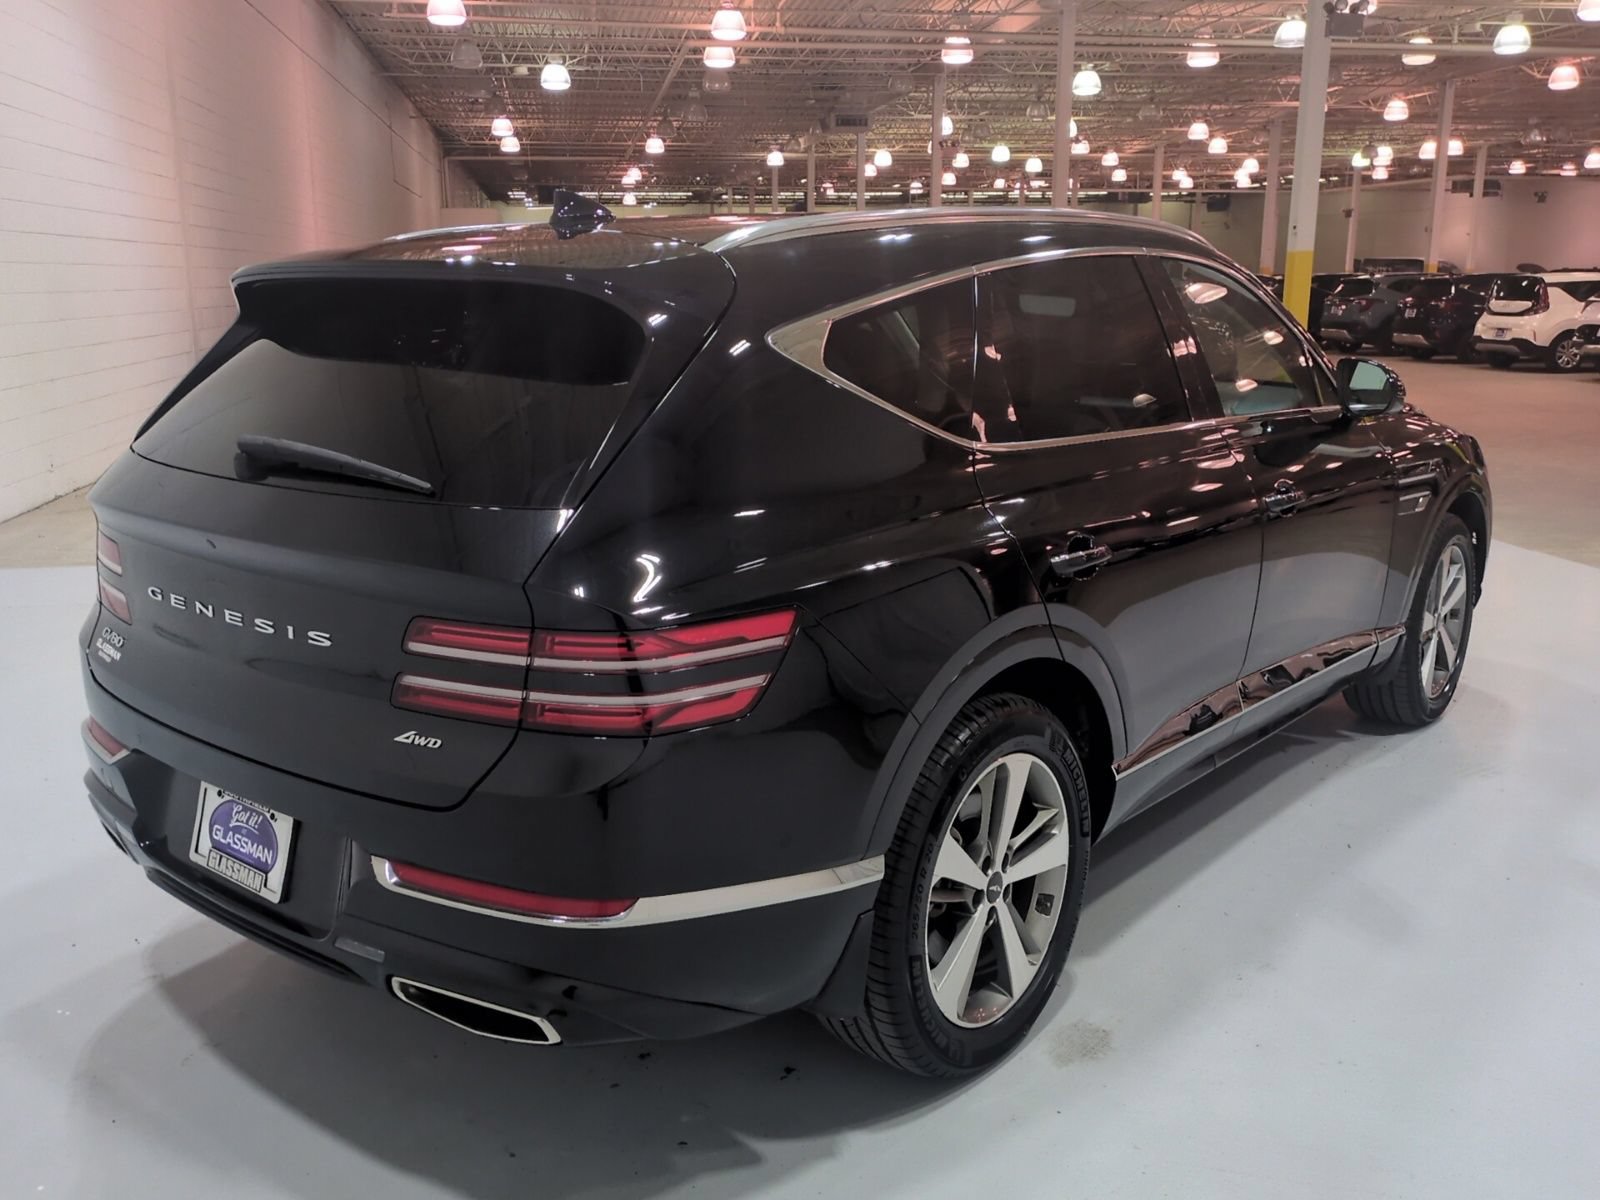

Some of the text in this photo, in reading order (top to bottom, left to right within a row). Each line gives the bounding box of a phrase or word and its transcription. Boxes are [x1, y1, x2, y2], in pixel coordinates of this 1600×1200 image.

[147, 586, 332, 647] GENESIS
[393, 730, 442, 748] AWD
[1062, 747, 1090, 834] MICHELIN
[231, 803, 263, 828] Got it!
[212, 824, 273, 865] GLASSMAN
[208, 850, 263, 892] GLASSMAN
